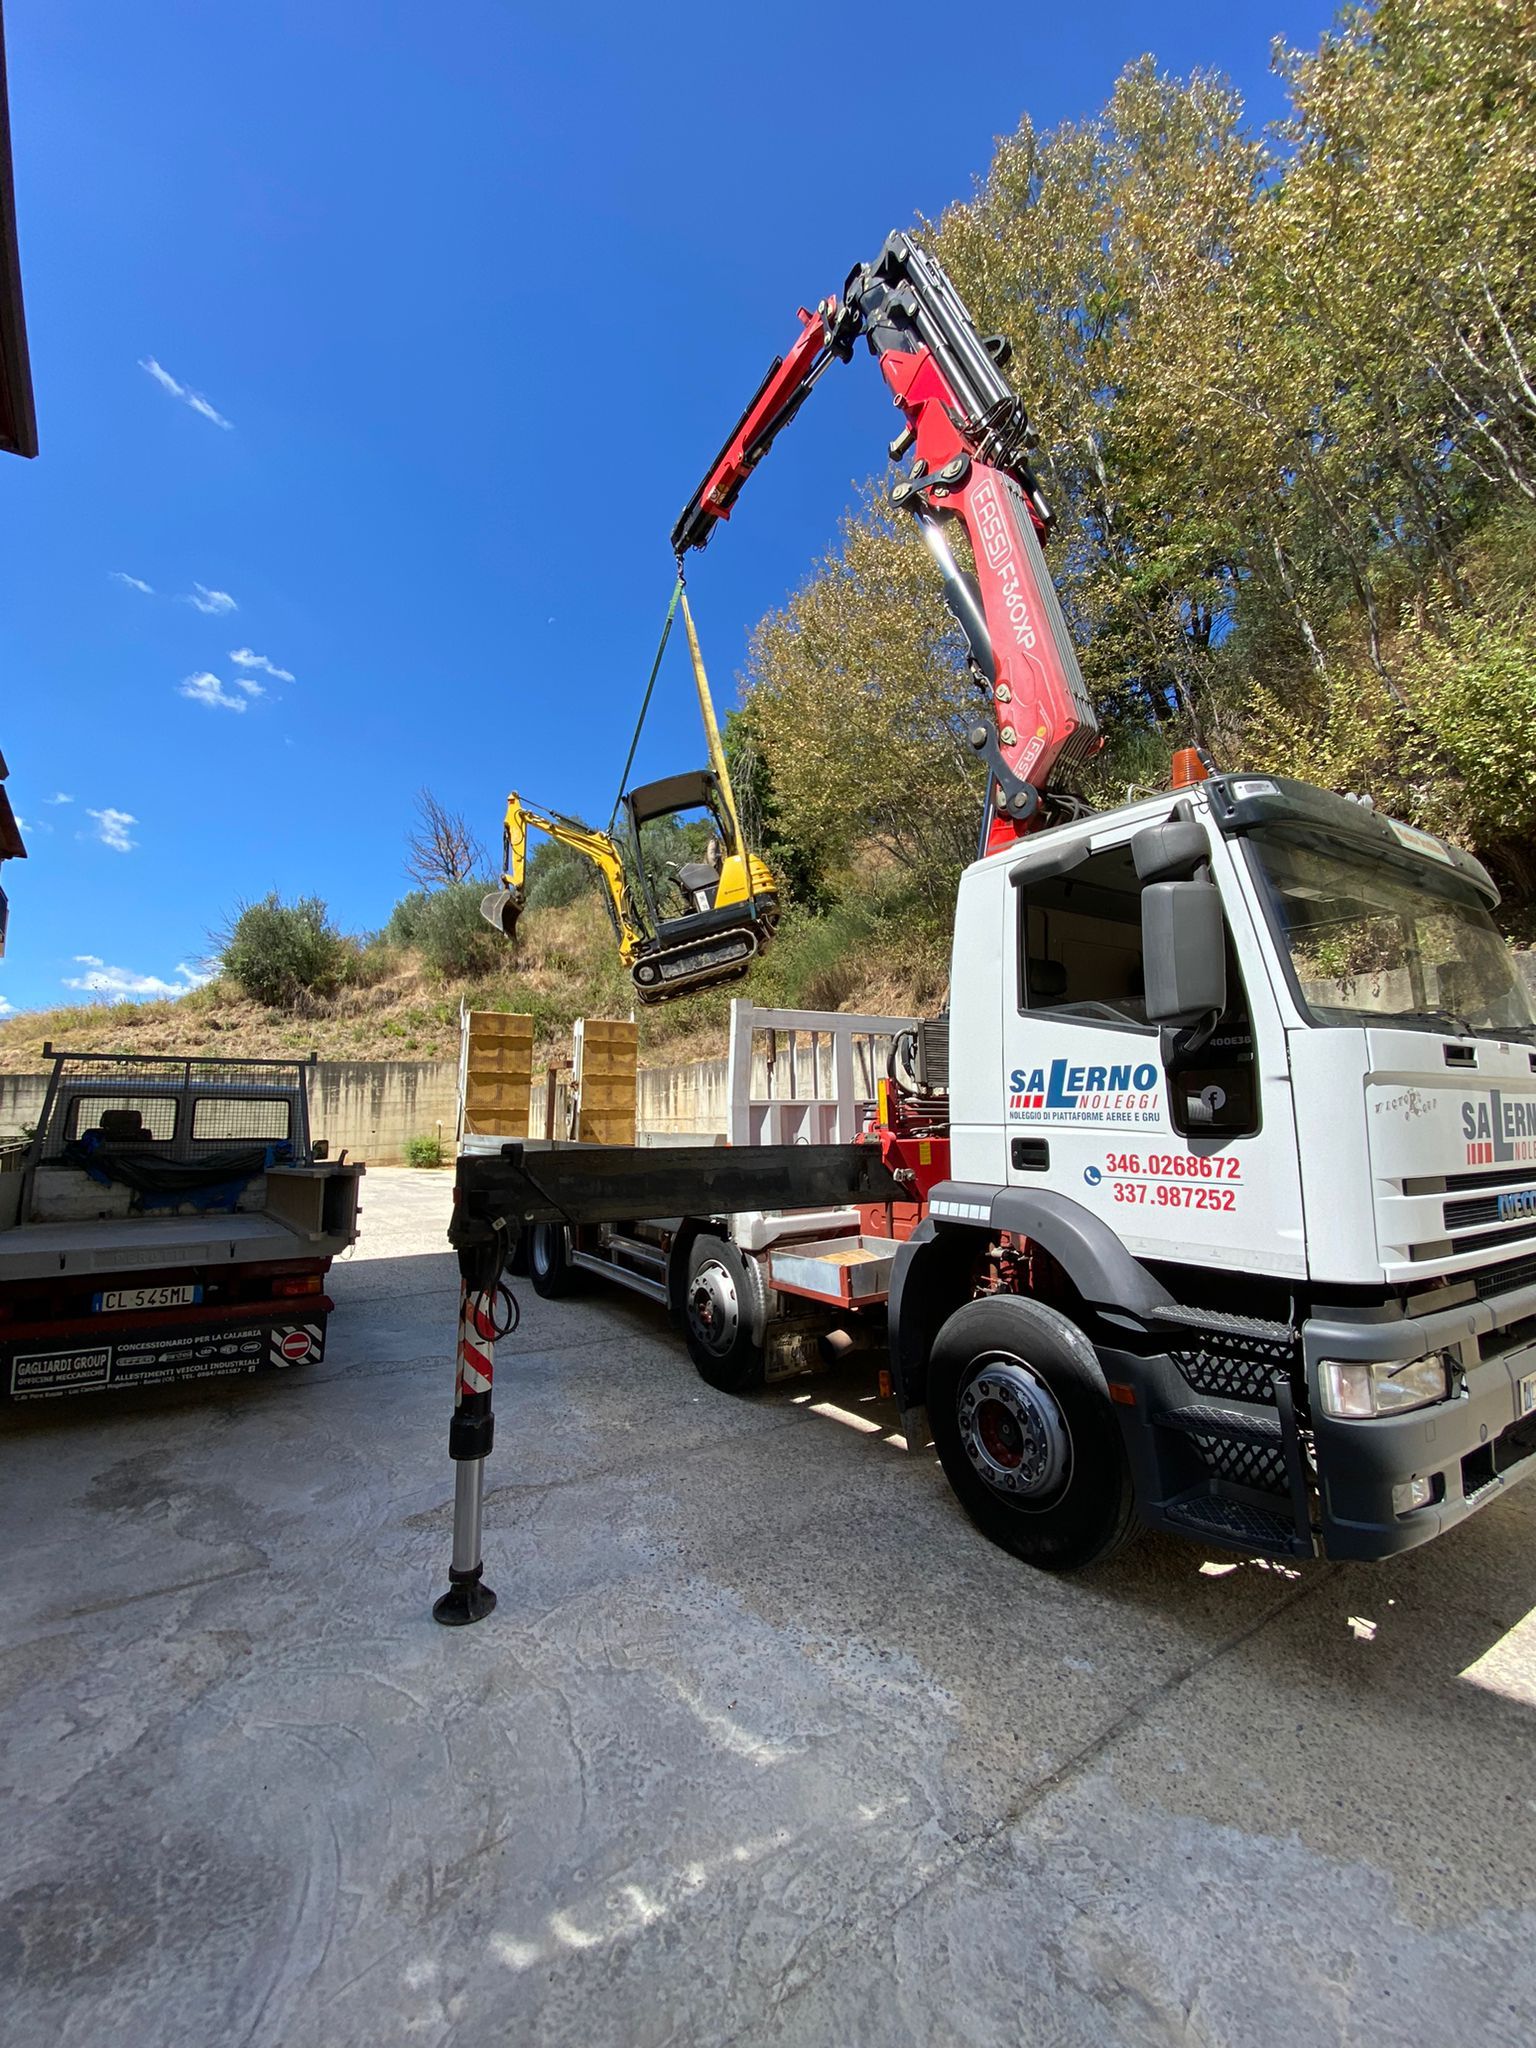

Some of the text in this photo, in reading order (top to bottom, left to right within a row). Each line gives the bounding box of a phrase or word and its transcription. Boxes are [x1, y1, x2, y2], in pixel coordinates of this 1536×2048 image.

[973, 488, 1010, 564] FASSI
[997, 561, 1036, 649] F360XP
[1015, 741, 1040, 780] FASS
[1009, 1059, 1158, 1108] SALERNO
[1078, 1094, 1158, 1109] NOLEGGI
[1009, 1111, 1160, 1122] NOLEGGIO DI PIATTAFORME AEREE E GRU
[1106, 1153, 1241, 1179] 346.0268672
[1113, 1183, 1236, 1212] 337.987252
[105, 1293, 128, 1309] CL
[117, 1338, 193, 1352] CONCESSIONARIO
[195, 1335, 210, 1343] PER
[212, 1333, 222, 1341] LA
[223, 1329, 262, 1340] CALABRIA
[18, 1354, 107, 1376] GAGLIARDI GROUP
[114, 1358, 260, 1381] ALLESTIMENTI VEICOLI INDUSTRIALI
